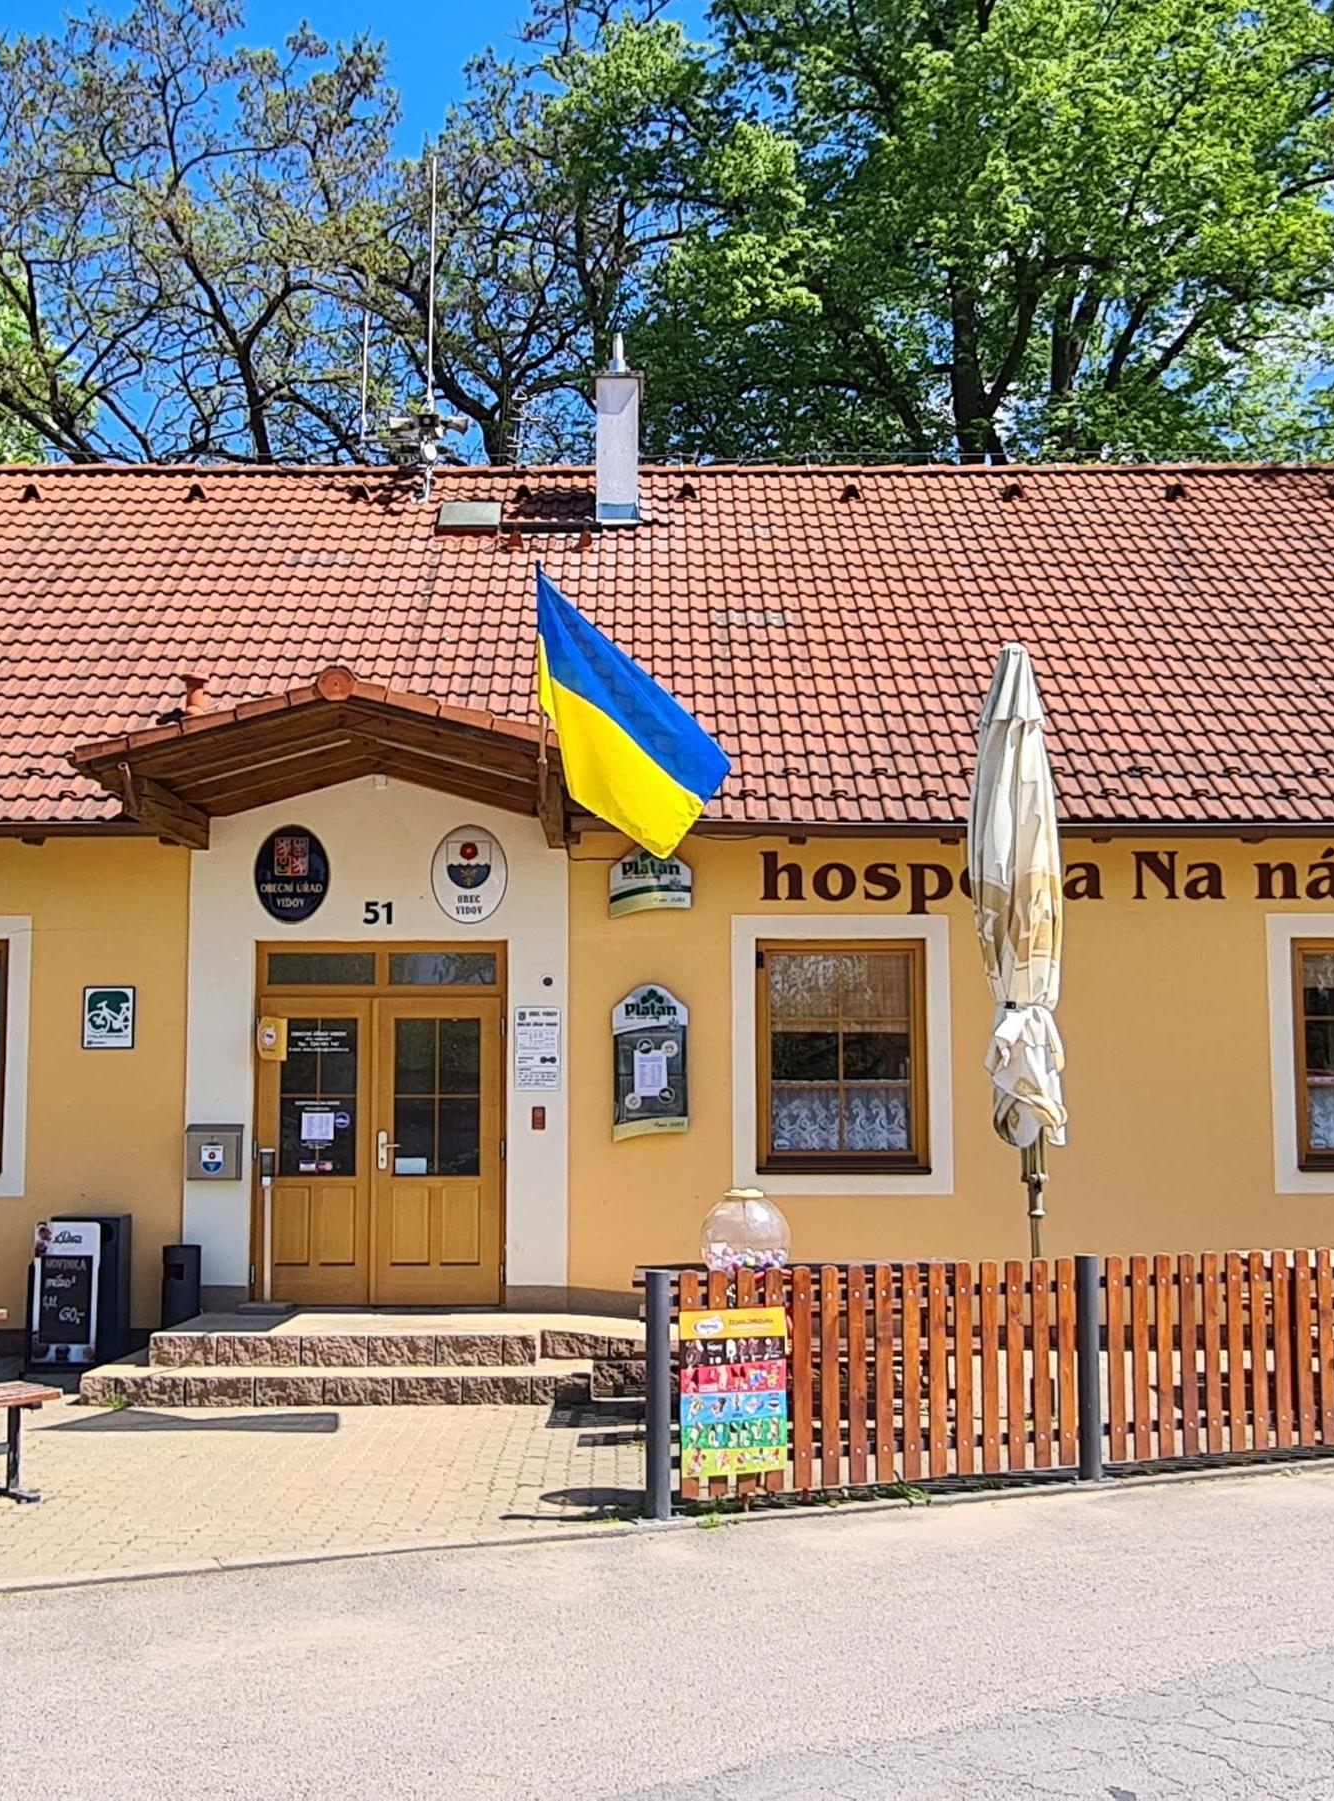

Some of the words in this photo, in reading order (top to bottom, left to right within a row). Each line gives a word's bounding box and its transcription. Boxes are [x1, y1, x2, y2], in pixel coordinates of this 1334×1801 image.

[621, 860, 682, 876] Platan
[260, 881, 294, 893] OBECNÍ
[759, 850, 1105, 915] hospa
[1130, 850, 1227, 900] Na
[276, 897, 305, 908] VIDOV
[457, 894, 481, 904] OBEC
[362, 901, 393, 925] 51
[455, 905, 483, 915] VIDOV
[624, 1002, 678, 1016] Platan
